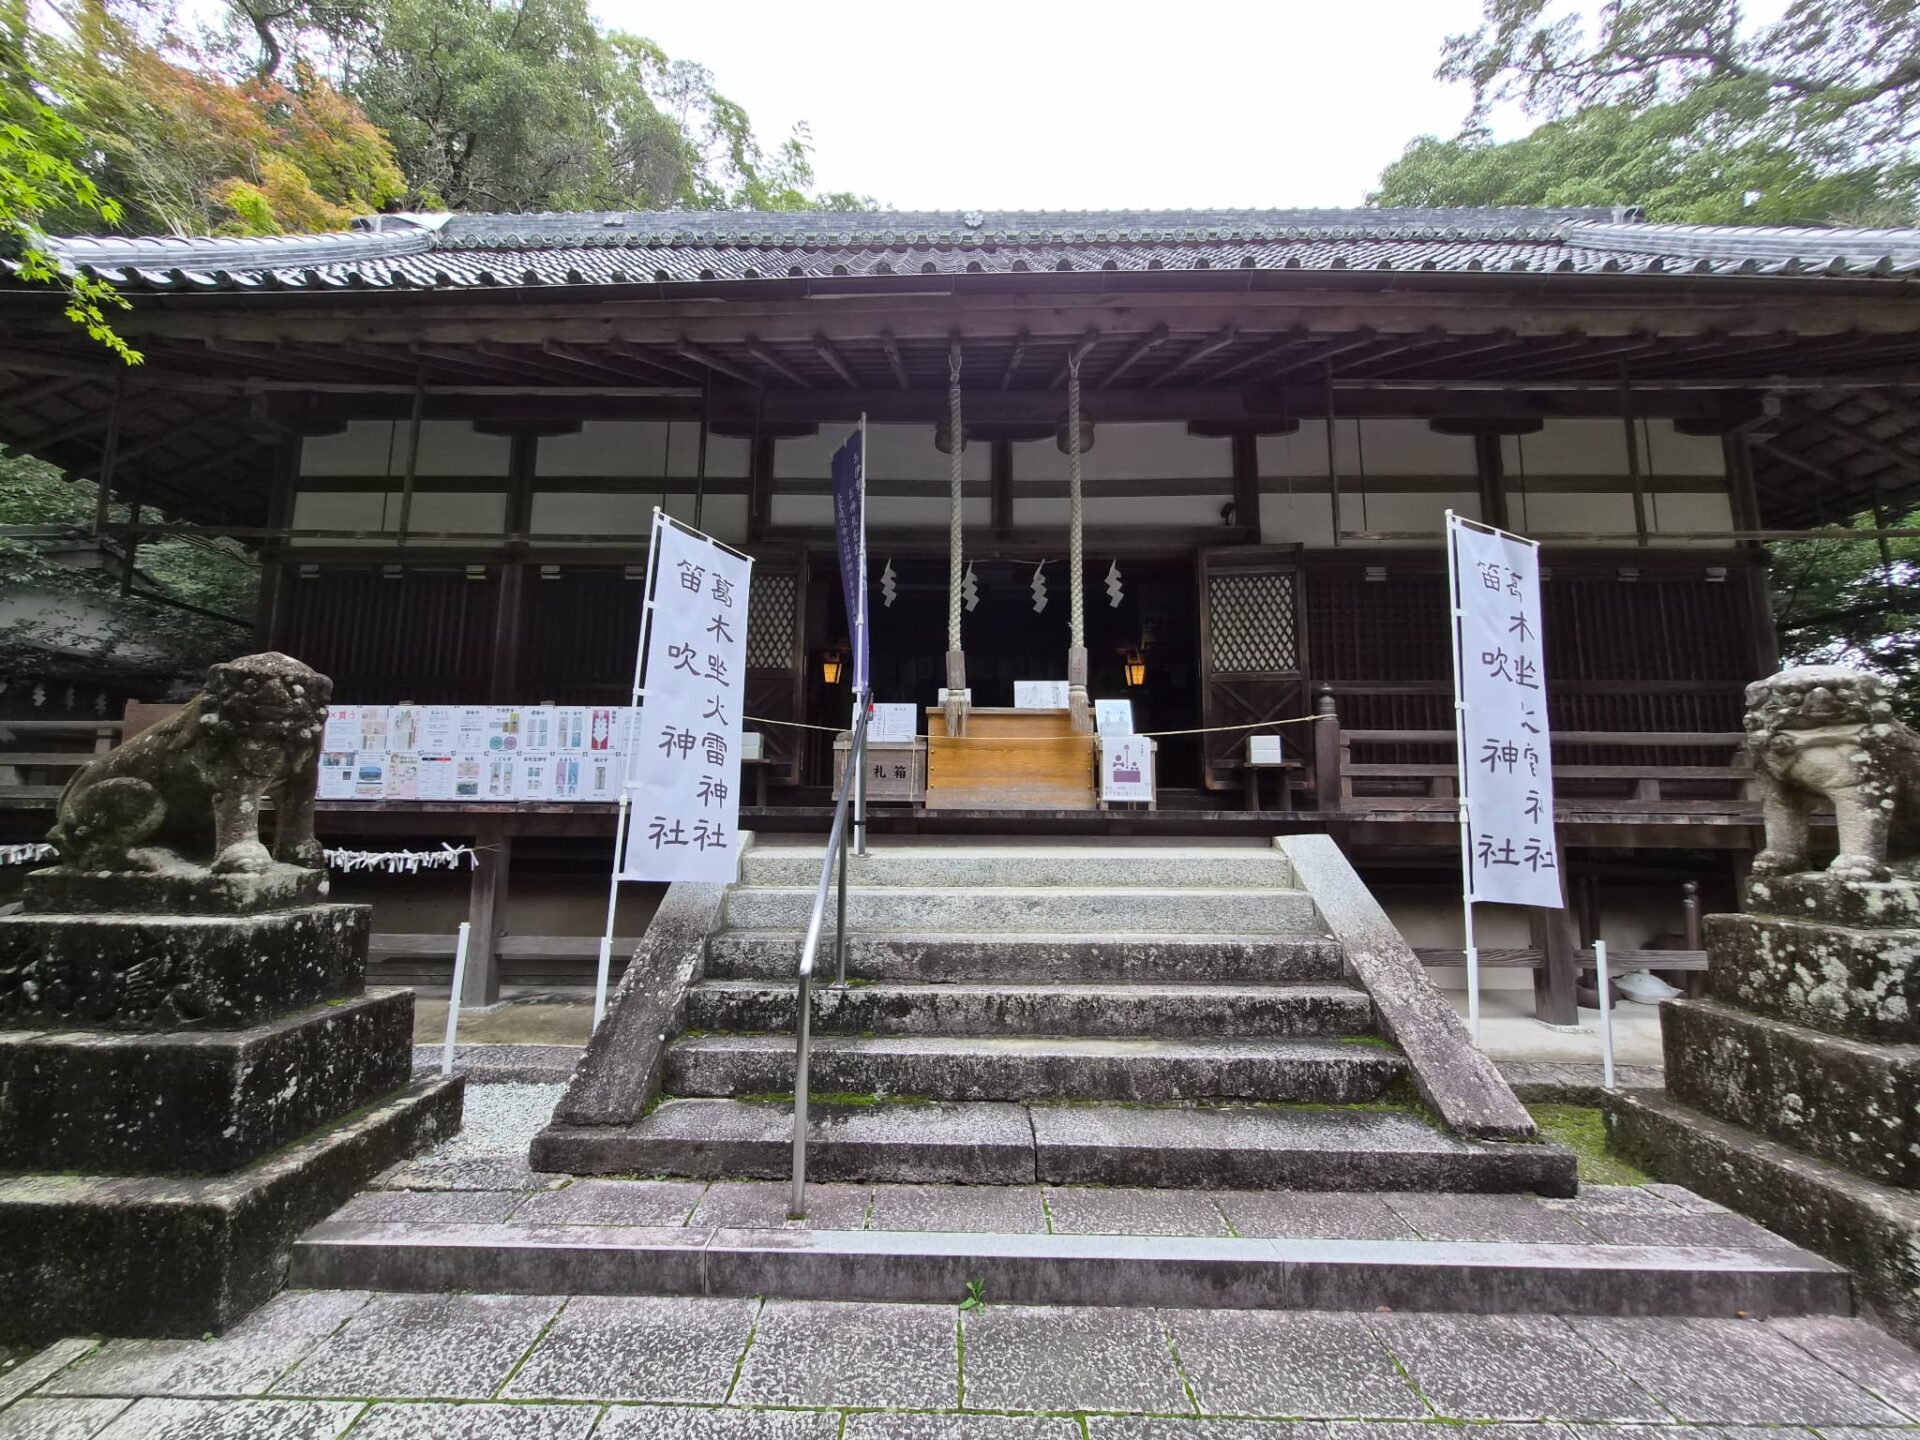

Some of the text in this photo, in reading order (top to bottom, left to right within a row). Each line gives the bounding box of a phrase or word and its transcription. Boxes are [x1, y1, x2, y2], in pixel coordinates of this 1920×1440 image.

[648, 559, 705, 850] 笛吹神社
[692, 572, 735, 852] 葛木坐火雷神社
[1476, 560, 1521, 869] 笛吹神社
